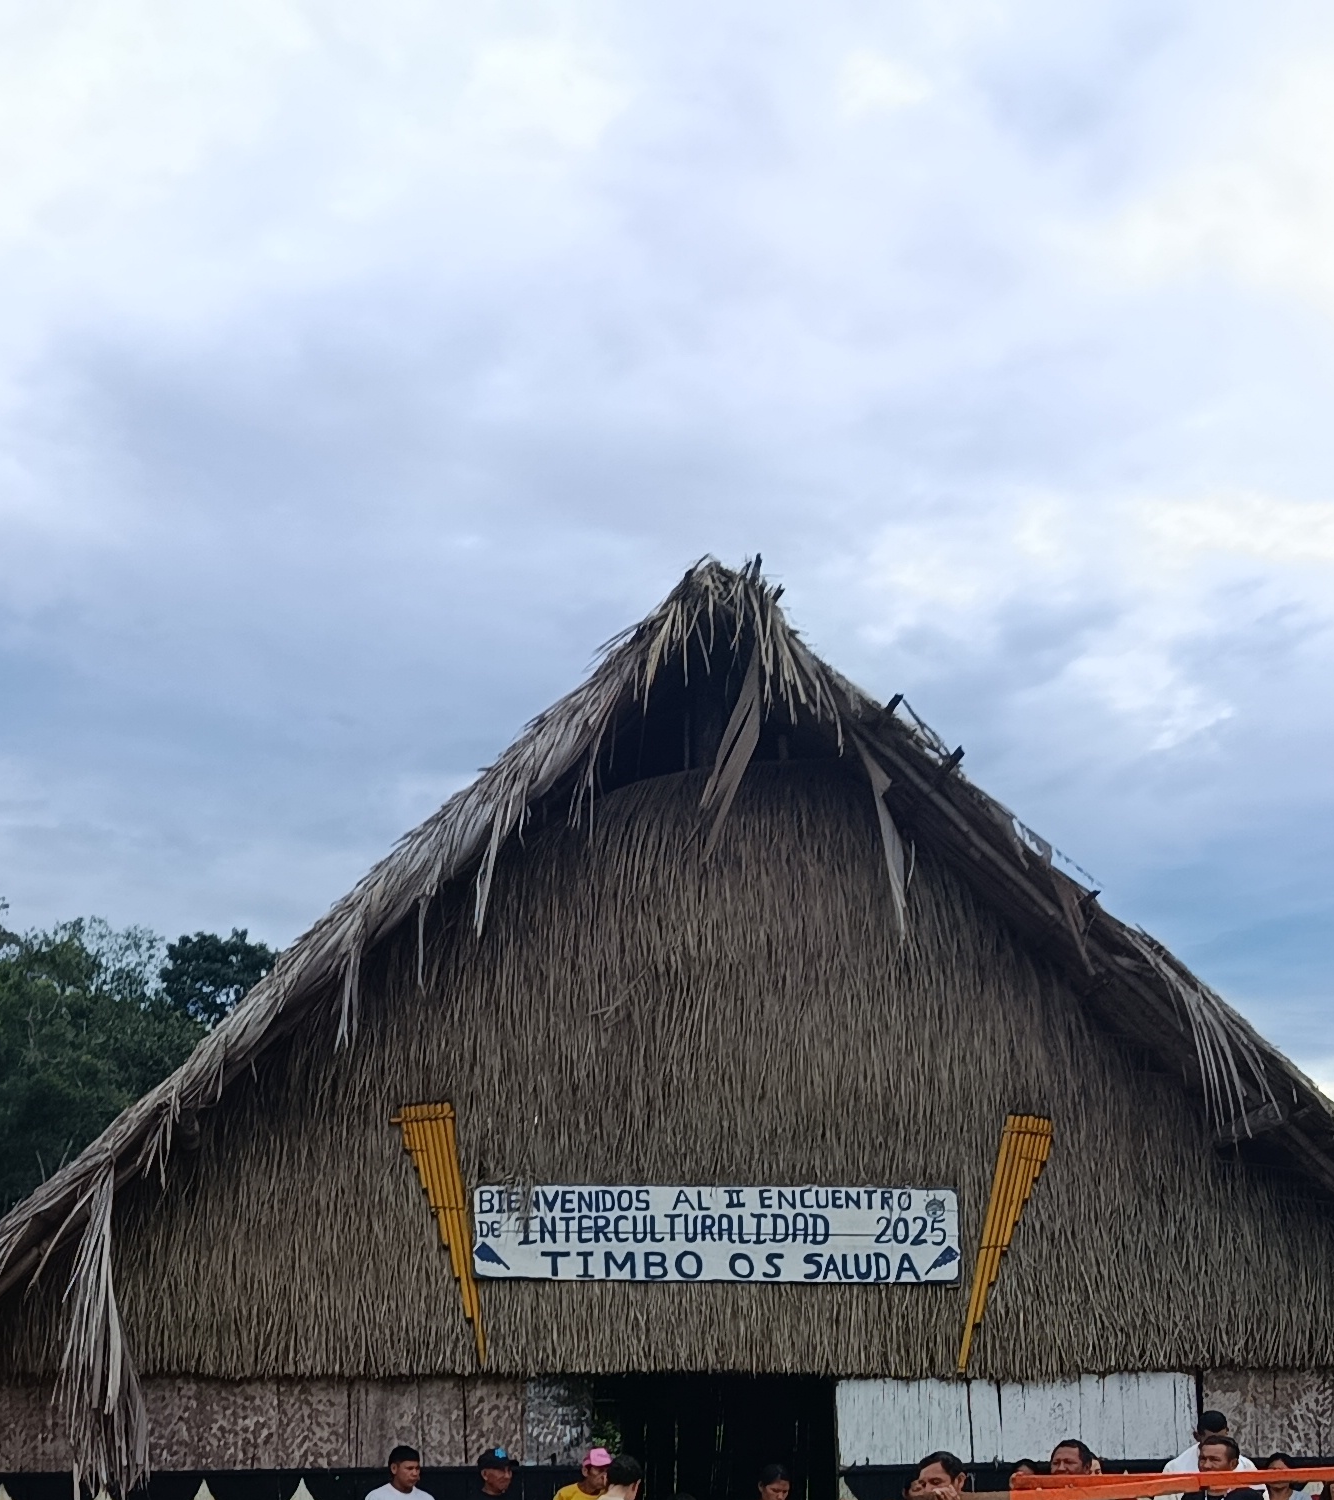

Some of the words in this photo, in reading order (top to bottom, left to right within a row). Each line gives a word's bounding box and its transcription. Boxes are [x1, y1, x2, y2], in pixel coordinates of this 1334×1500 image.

[671, 1189, 712, 1212] AL
[723, 1188, 747, 1209] II
[758, 1188, 912, 1212] ENCUENTRO
[478, 1220, 502, 1239] DE
[517, 1212, 830, 1246] INTERCULTURALIDAD
[873, 1215, 947, 1246] 2025
[540, 1250, 703, 1280] TIMBO
[728, 1252, 785, 1279] OS
[802, 1251, 921, 1282] SALUDA
